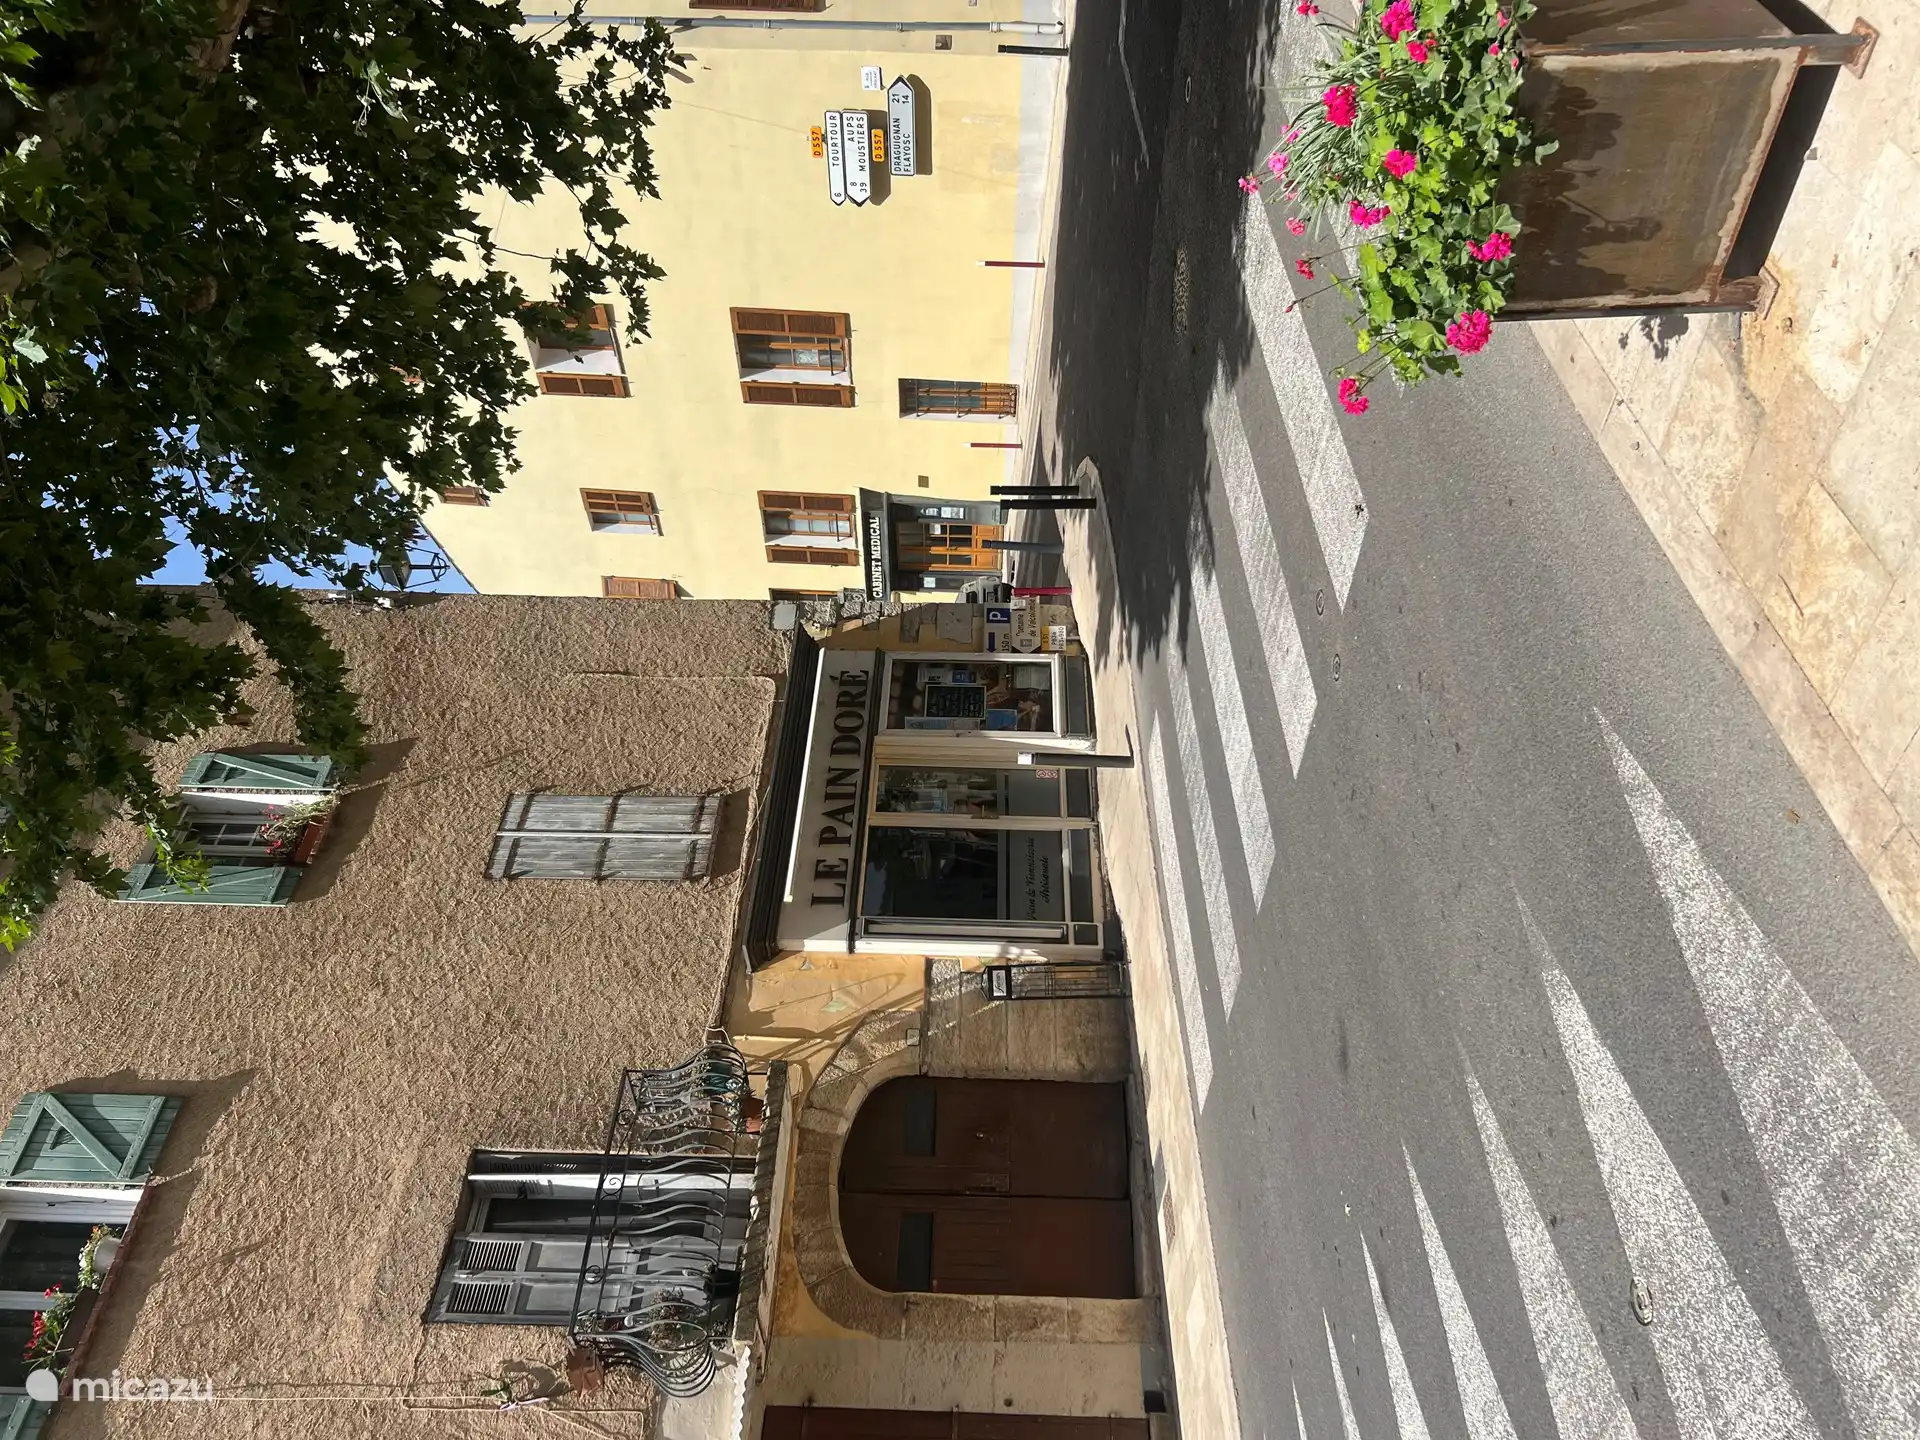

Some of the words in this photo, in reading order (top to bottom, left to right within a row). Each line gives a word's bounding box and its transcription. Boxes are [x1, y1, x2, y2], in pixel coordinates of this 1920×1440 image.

[892, 93, 900, 104] 21
[902, 95, 909, 104] 14
[811, 131, 820, 147] 557
[829, 115, 839, 167] TOURTOUR
[846, 116, 855, 142] AUPS
[856, 116, 866, 172] MOUSTIERS
[892, 117, 902, 172] DRAGUIGNAN
[903, 133, 911, 172] FLAYOSC
[860, 182, 867, 193] 39
[869, 517, 882, 559] MEDICAL
[871, 560, 883, 598] CABINET
[989, 612, 1008, 620] P
[1002, 641, 1010, 652] 150
[829, 670, 869, 758] DORÉ
[818, 766, 860, 848] PAIN
[810, 858, 849, 908] LE
